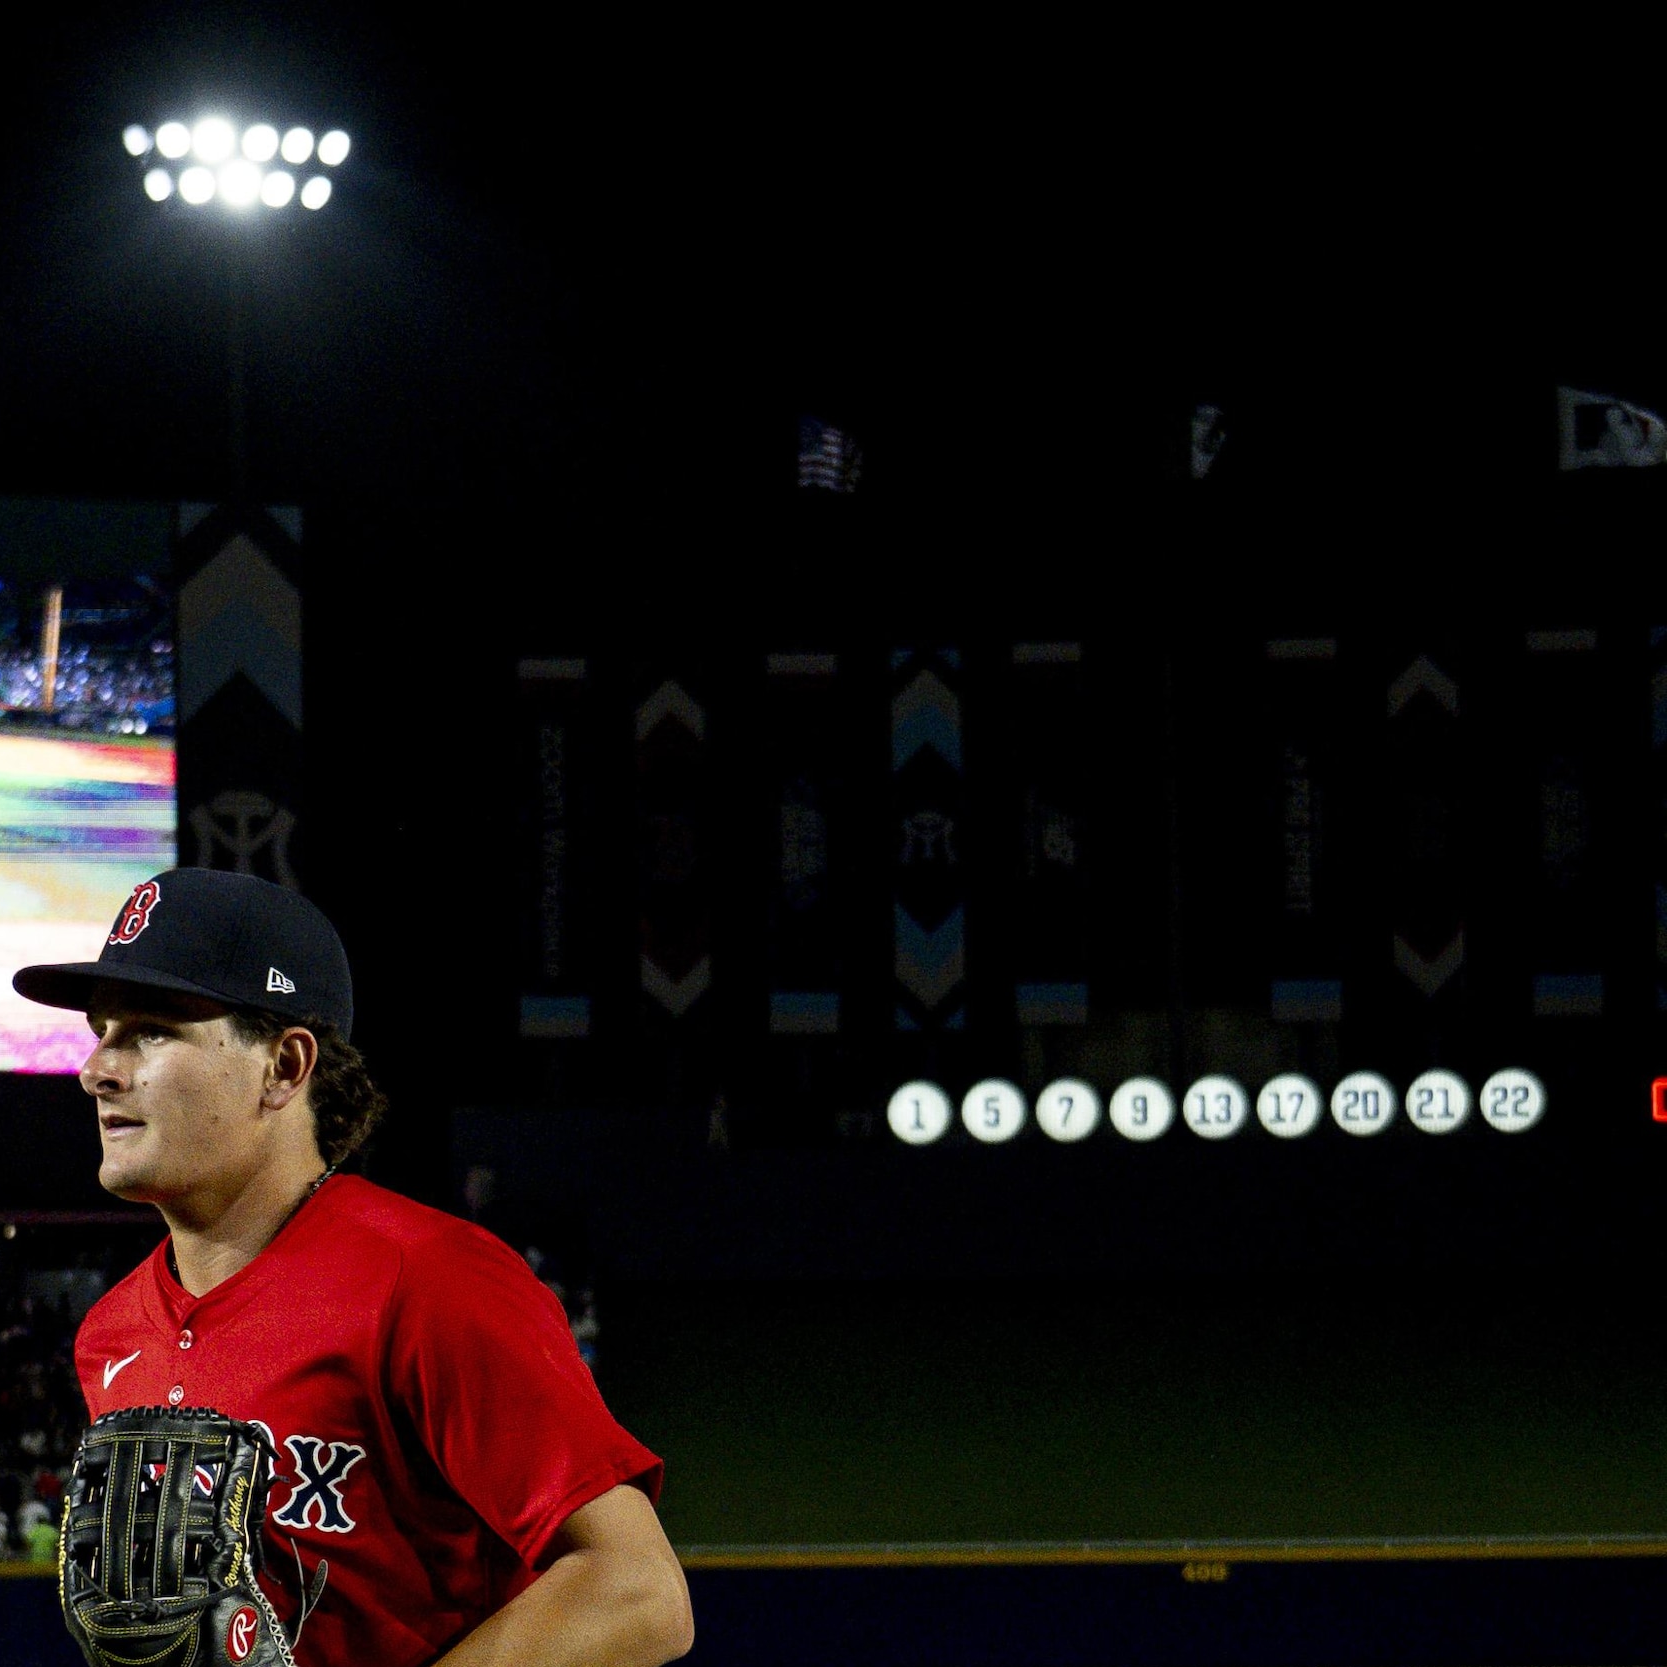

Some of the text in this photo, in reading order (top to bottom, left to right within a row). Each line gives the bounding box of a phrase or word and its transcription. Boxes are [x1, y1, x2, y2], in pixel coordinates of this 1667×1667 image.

[108, 881, 161, 945] B
[910, 1085, 1530, 1130] 1 5 7 9 13 17 20 21 22
